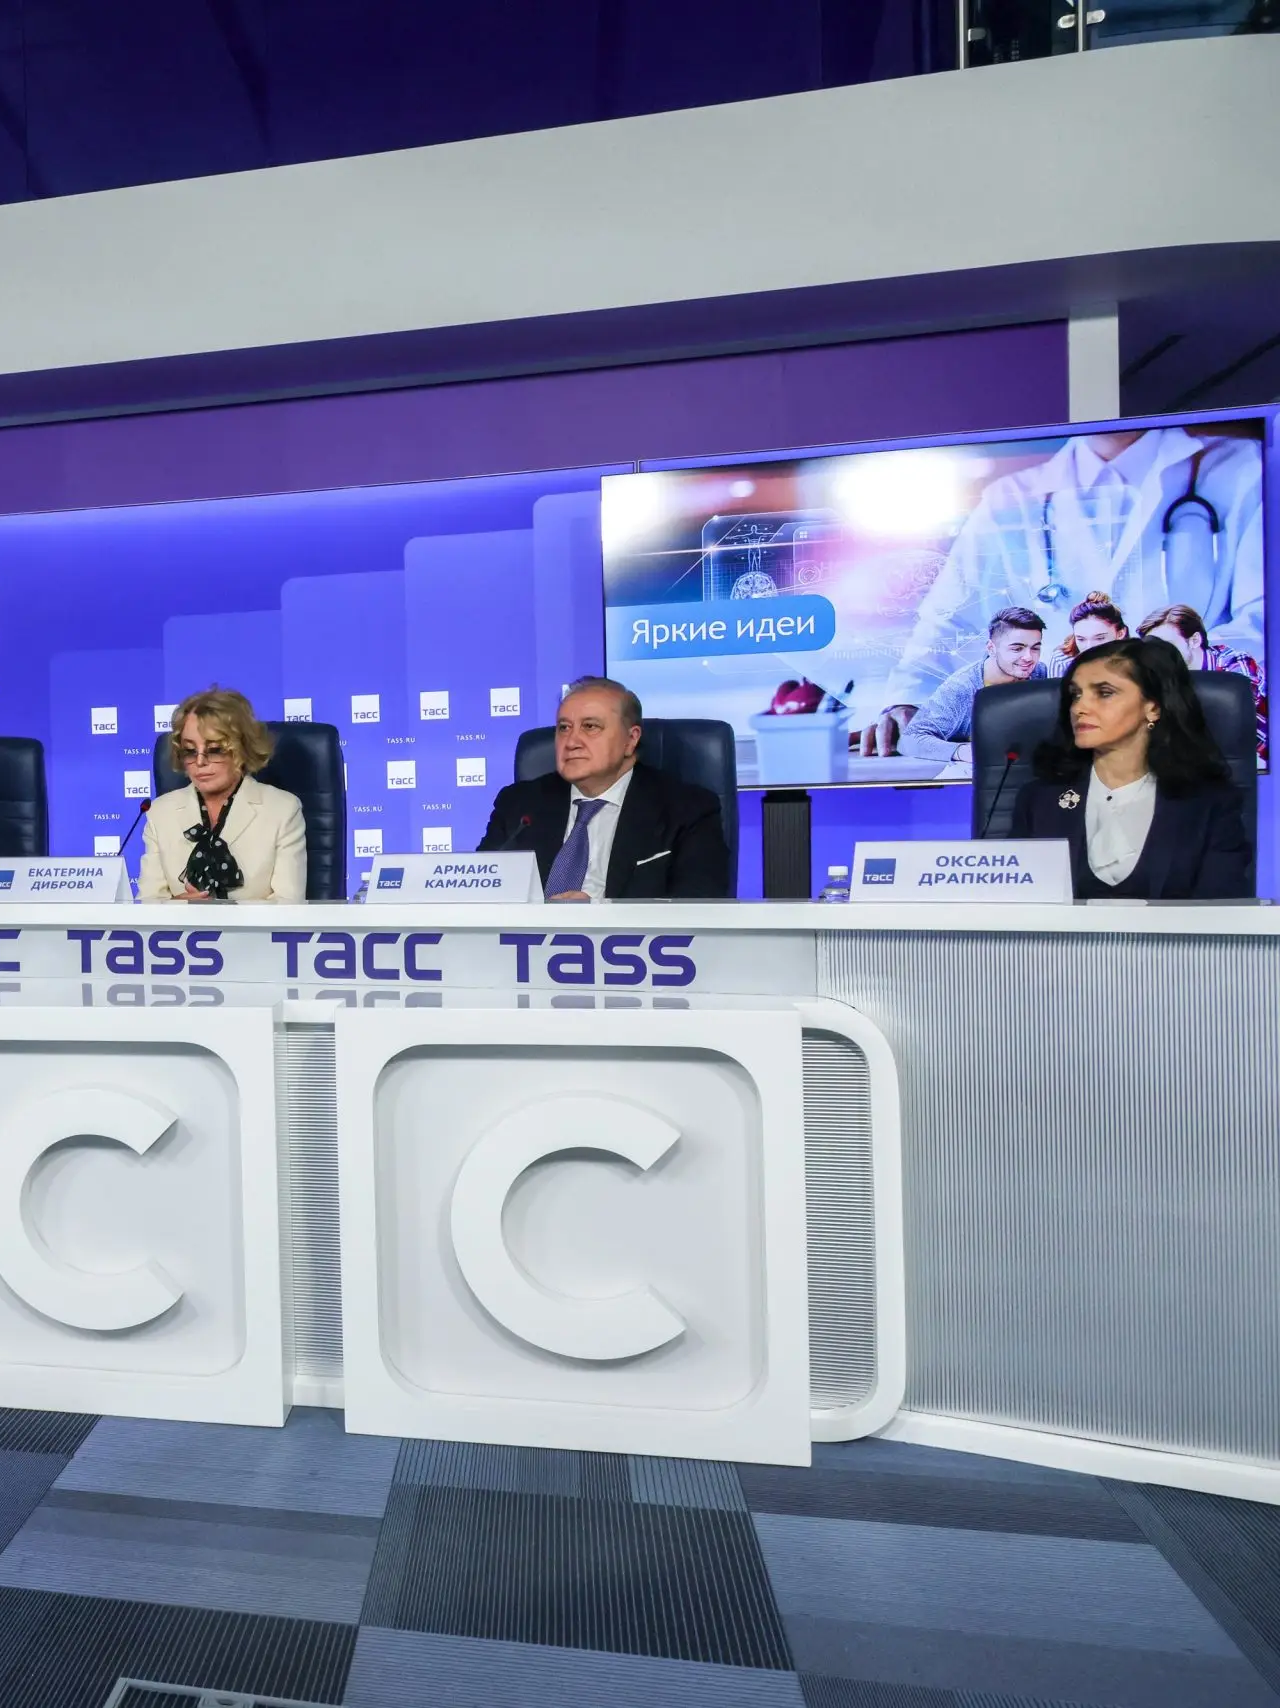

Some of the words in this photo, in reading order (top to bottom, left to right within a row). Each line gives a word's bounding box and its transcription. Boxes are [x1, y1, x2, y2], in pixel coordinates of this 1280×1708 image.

[631, 618, 727, 649] Яркие
[736, 614, 816, 643] идеи
[386, 736, 416, 744] TASS.RU
[456, 733, 486, 741] TASS.RU
[422, 803, 452, 811] TASS.RU
[935, 855, 1020, 867] ОКСАНА
[28, 867, 104, 877] ЕКАТЕРИНА
[433, 864, 498, 875] АРМАИС
[424, 878, 502, 889] КАМАЛОВ
[918, 872, 1034, 886] ДРАПКИНА
[30, 881, 94, 891] ДИБРОВА
